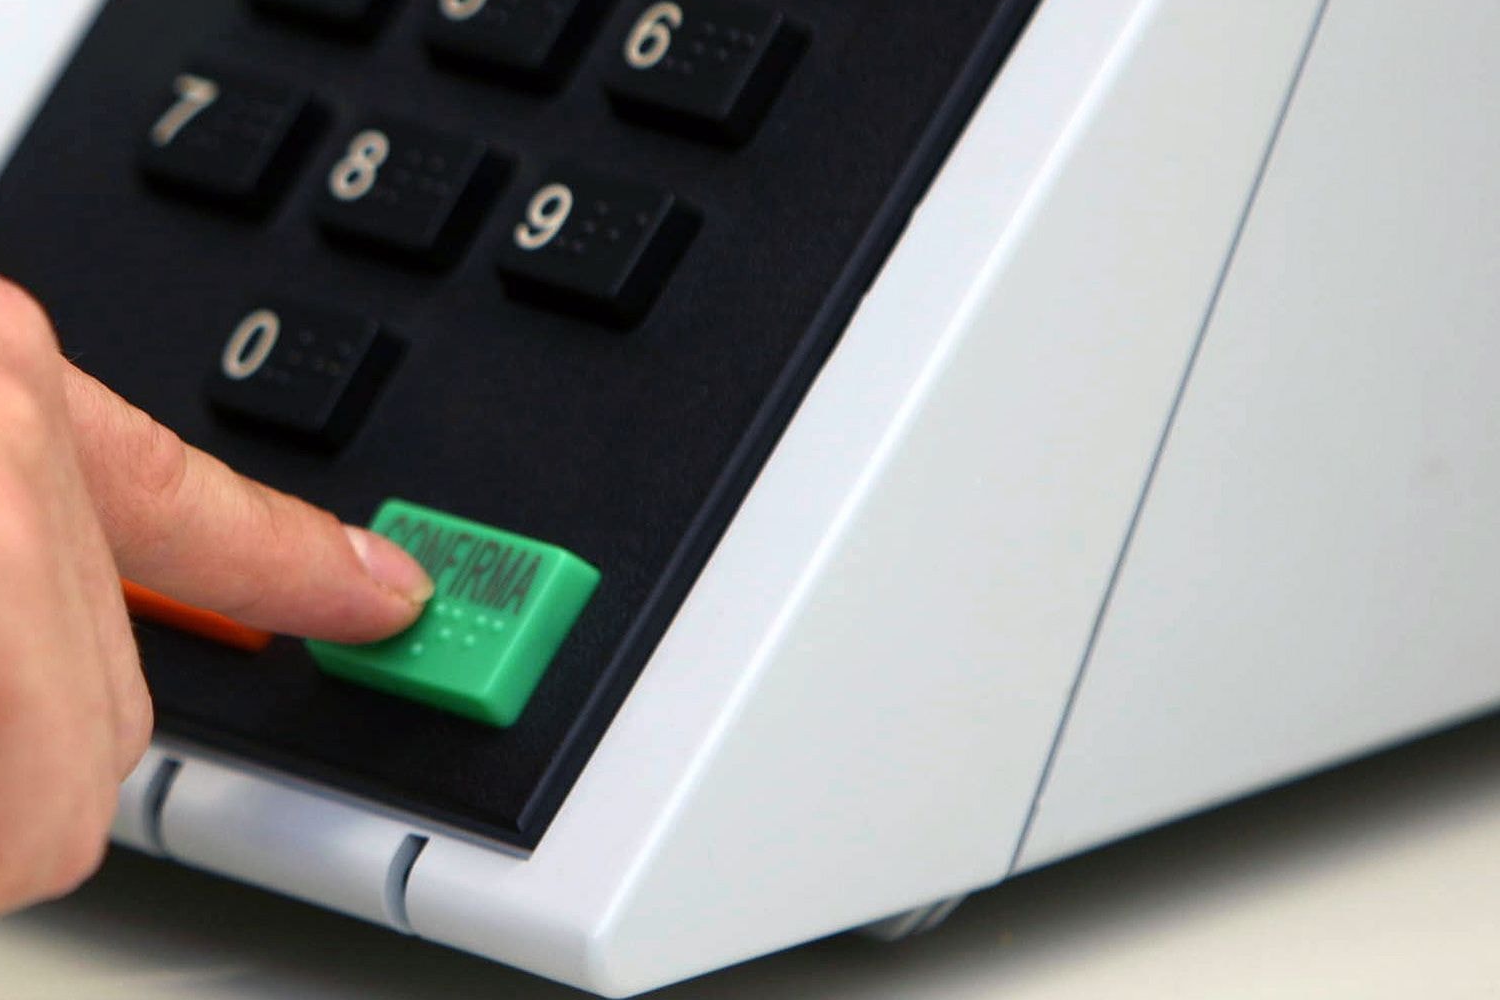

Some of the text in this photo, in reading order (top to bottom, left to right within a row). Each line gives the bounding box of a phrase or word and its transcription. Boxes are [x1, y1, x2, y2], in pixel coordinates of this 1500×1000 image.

[623, 1, 684, 69] 6
[151, 73, 218, 145] 7
[328, 130, 390, 201] 8
[514, 183, 574, 251] 9
[222, 310, 281, 380] 0
